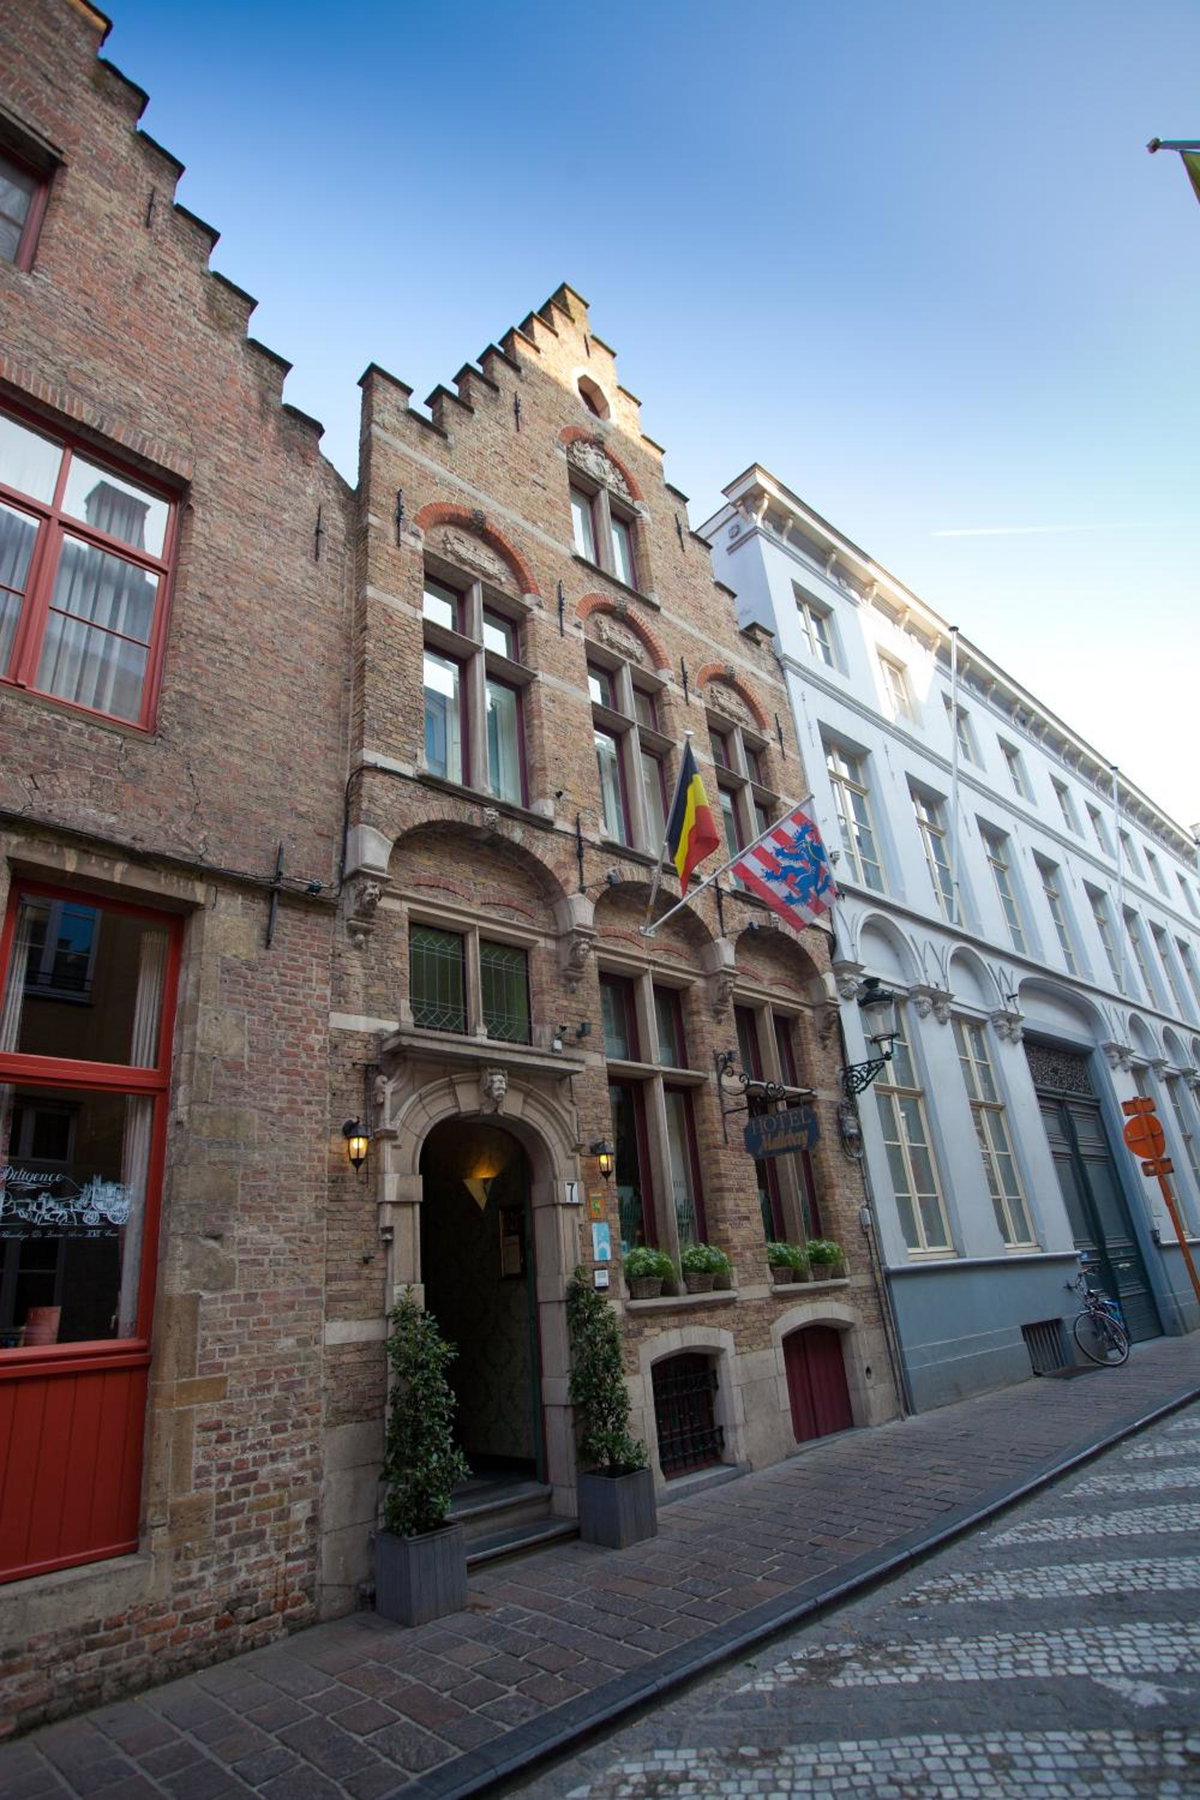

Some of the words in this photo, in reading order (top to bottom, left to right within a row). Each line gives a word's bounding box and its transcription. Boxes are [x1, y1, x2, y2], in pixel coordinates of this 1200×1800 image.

[751, 1108, 812, 1135] HOTEL
[2, 1165, 63, 1183] Diligence
[566, 1182, 576, 1202] 7
